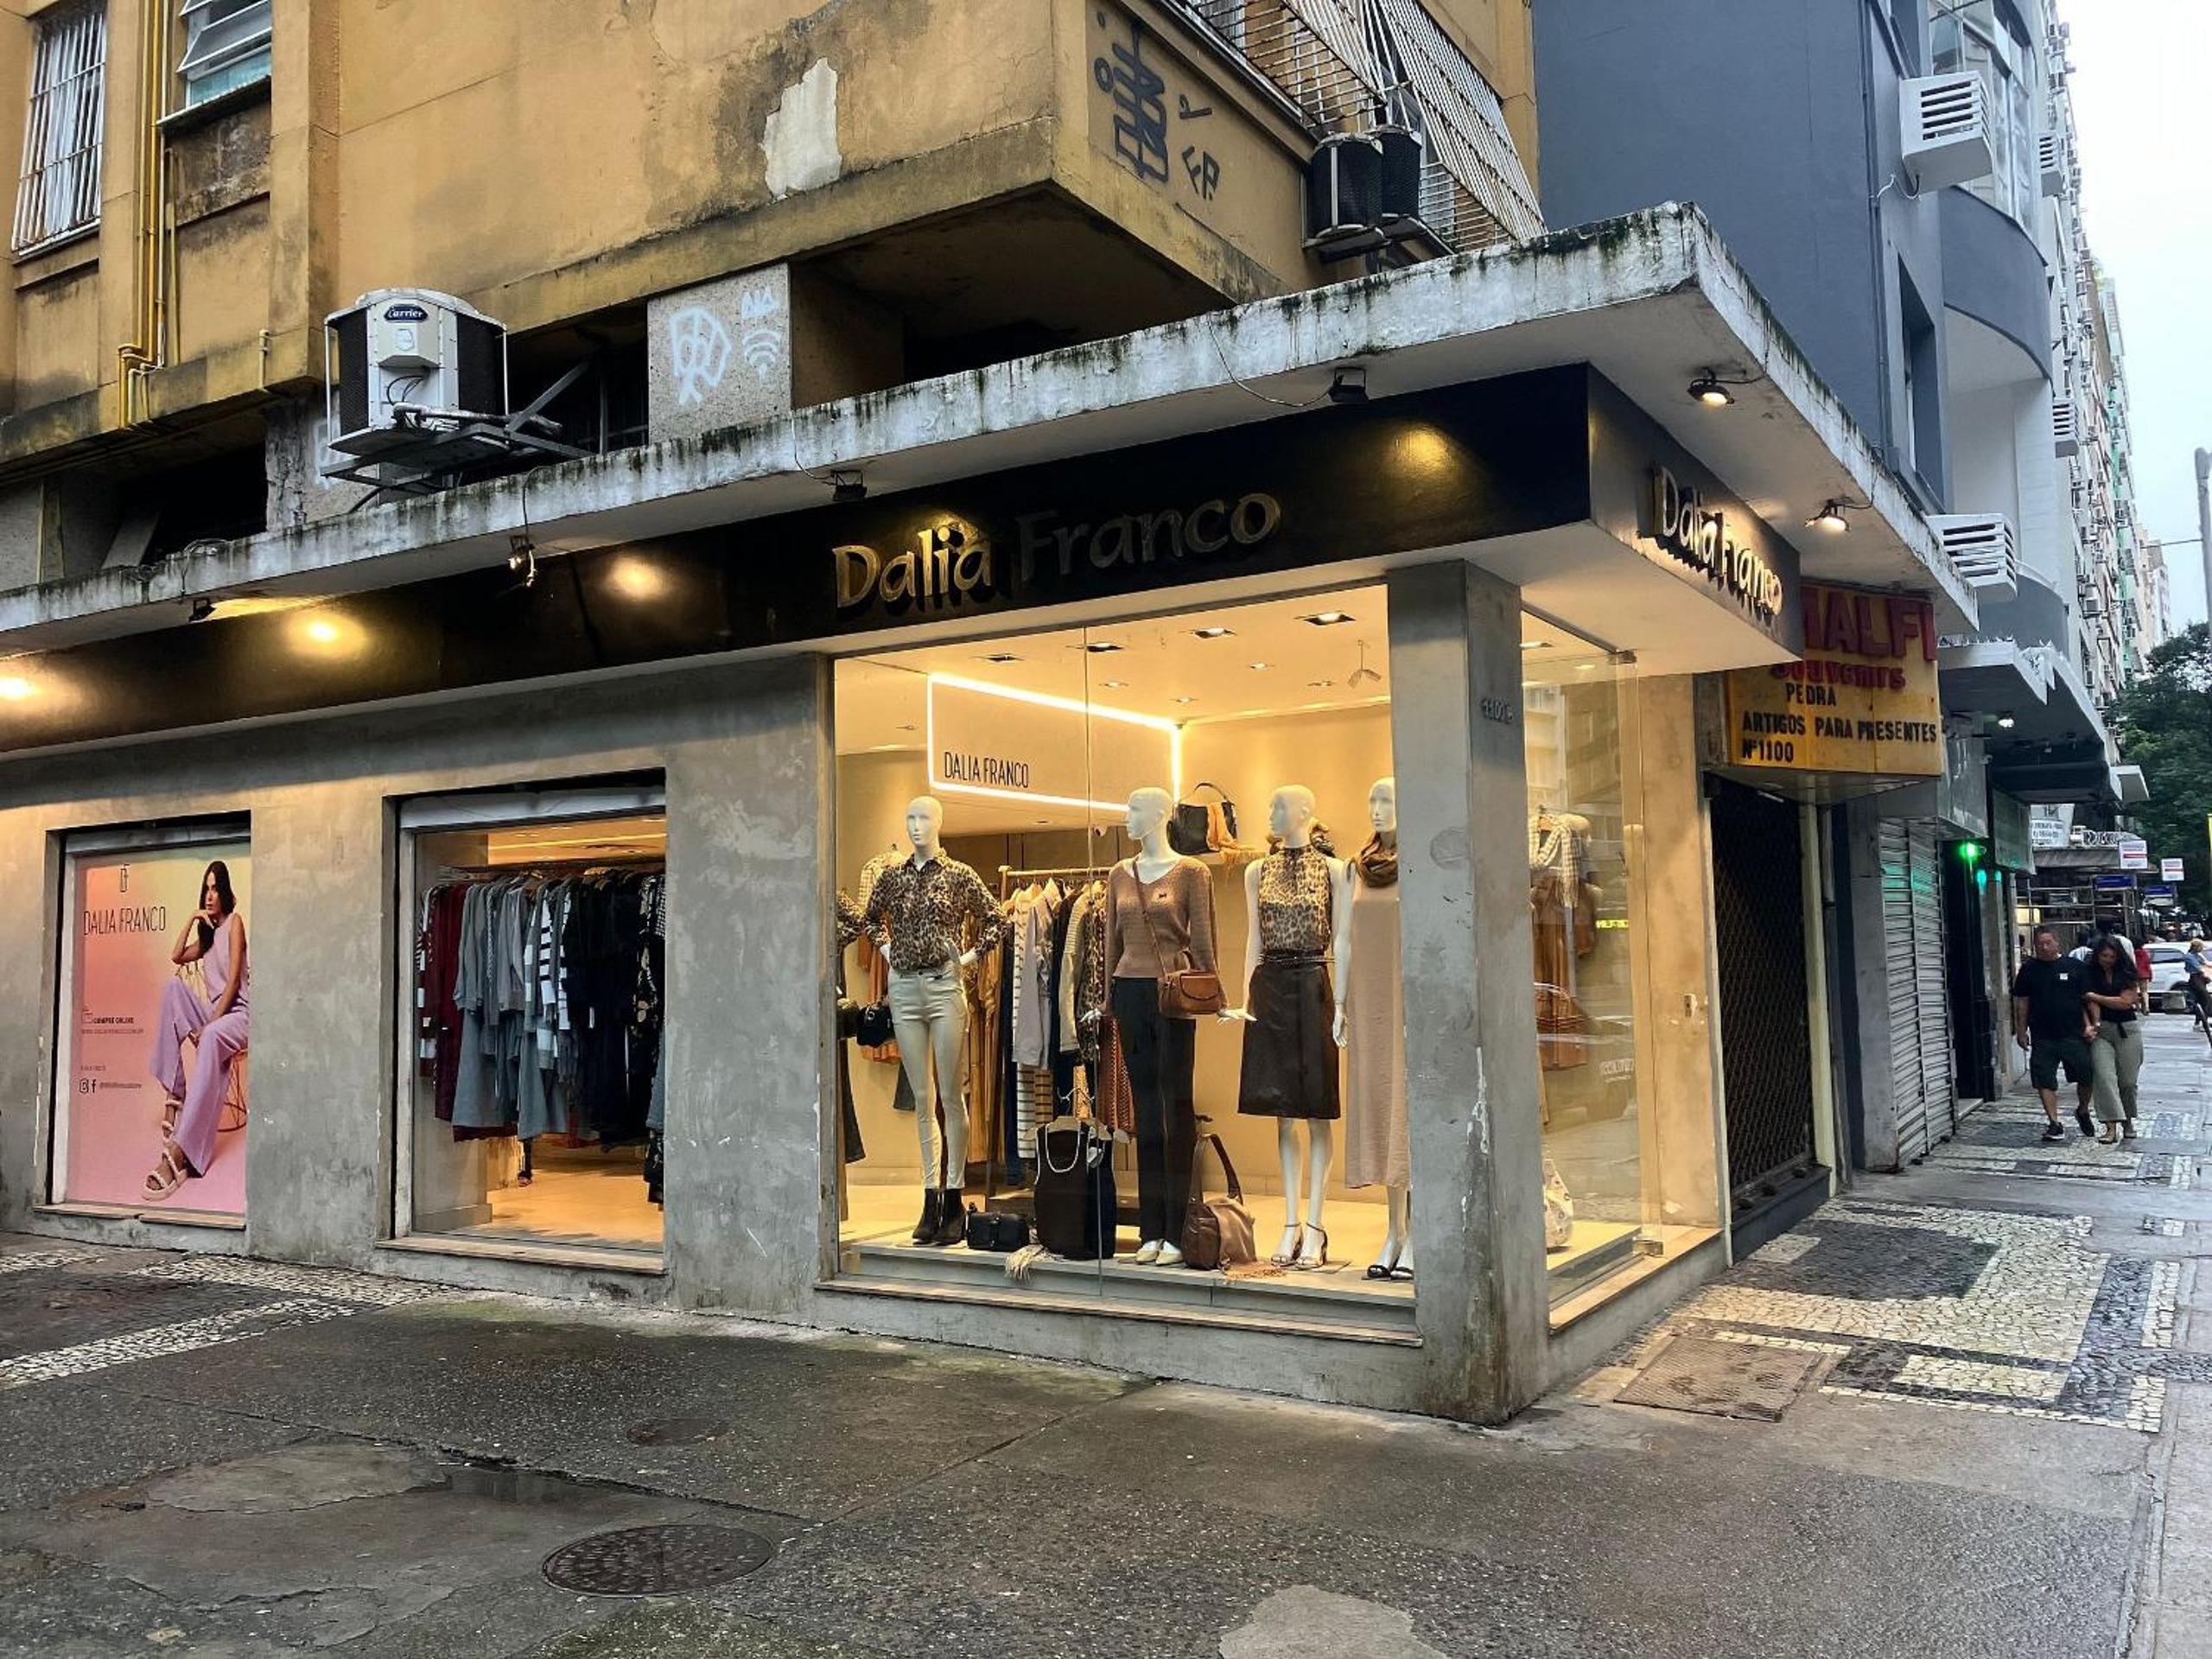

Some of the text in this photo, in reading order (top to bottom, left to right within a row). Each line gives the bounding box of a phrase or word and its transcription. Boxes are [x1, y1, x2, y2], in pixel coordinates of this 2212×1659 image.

[388, 306, 423, 318] Carrier
[1653, 465, 1718, 570] Dalia
[831, 492, 1282, 608] Dalia Franco
[1785, 683, 1837, 707] PEDRA
[1742, 710, 1936, 743] ARTIGOS PARA PRESENTES
[944, 752, 1029, 788] DALIA FRANCO
[83, 906, 167, 936] DALIA FRANCO
